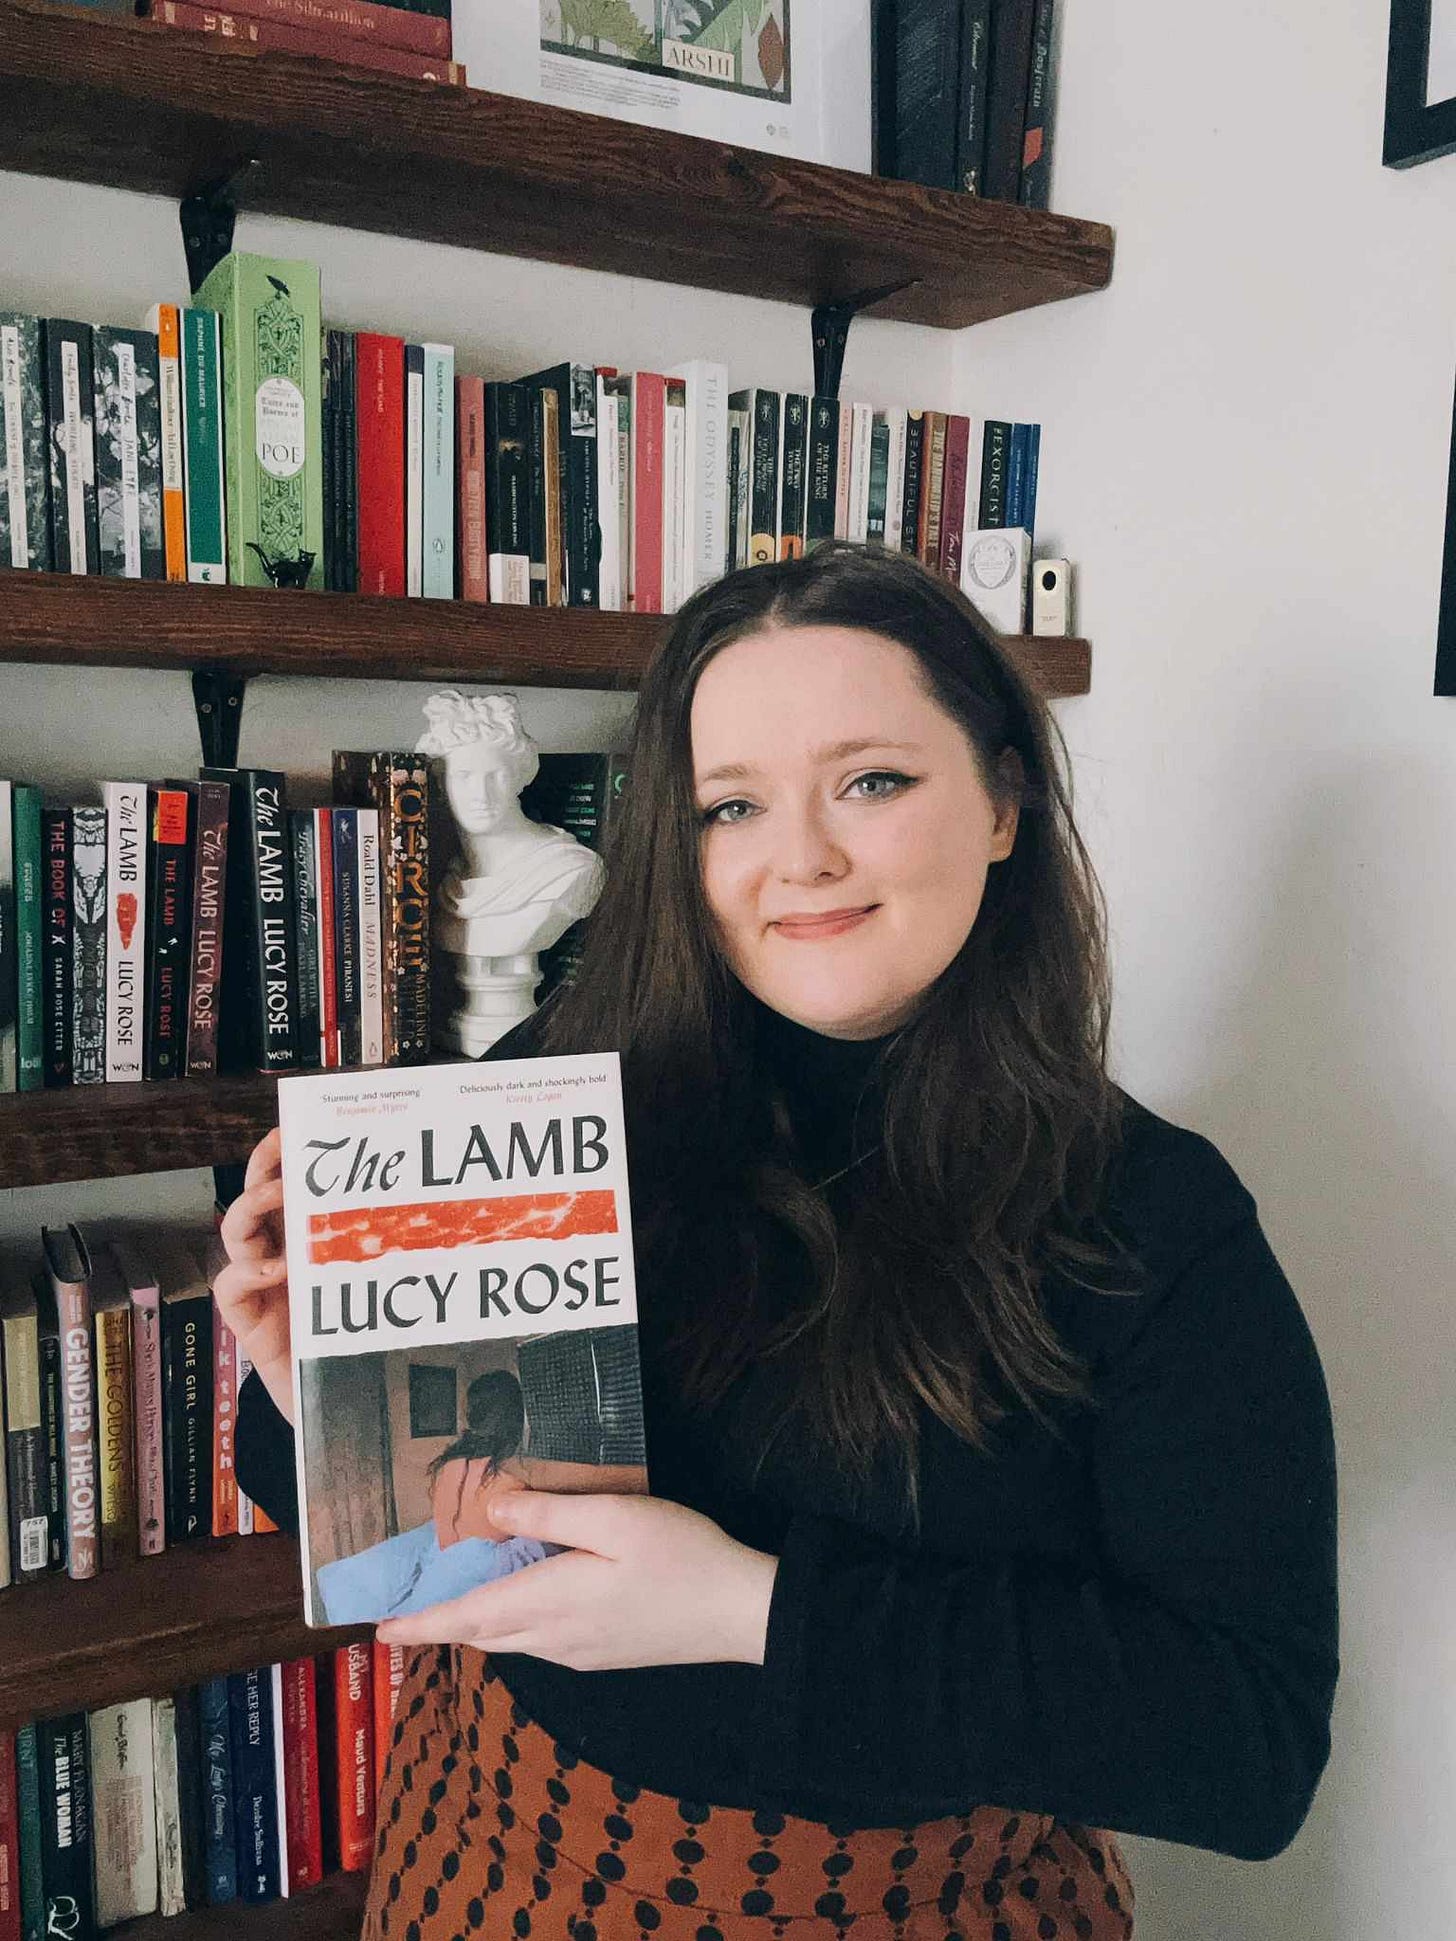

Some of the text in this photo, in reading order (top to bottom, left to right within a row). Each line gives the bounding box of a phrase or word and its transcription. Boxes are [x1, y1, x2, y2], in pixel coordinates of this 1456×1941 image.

[262, 442, 302, 464] POE
[703, 420, 717, 502] ODYSSEY
[814, 476, 822, 500] KING
[821, 464, 829, 500] RETURN
[906, 428, 919, 518] BEAUTIFUL
[927, 430, 944, 548] THE HANDMAID'S TALE
[987, 435, 1003, 525] EXORCIST
[703, 509, 714, 561] HOMER
[118, 795, 138, 1045] The LAMB LUCY ROSE
[254, 787, 289, 1034] The LAMB LUCY ROSE
[293, 832, 315, 935] Tracy Chevalier
[363, 834, 378, 1000] Roald Dahl MADNESS
[393, 788, 431, 966] CIRCE
[51, 821, 66, 1051] THE BOOK OF X SARAH ROSE ETTER
[160, 859, 177, 1037] THE LAMB LUCY ROSE
[194, 829, 221, 1029] The LAMB LUCY ROSE
[341, 872, 353, 1002] SUSANNA CLARKE PIRANESI
[322, 1088, 420, 1104] Stunning and surprising
[459, 1074, 607, 1095] Deliciously dark and shockingly bold
[304, 1115, 609, 1197] The LAMB
[311, 1256, 620, 1336] LUCY ROSE
[105, 1342, 122, 1377] THE
[66, 1328, 95, 1538] GENDER THEORY
[106, 1384, 124, 1472] GOLDENS
[184, 1322, 197, 1504] GONE GIRL GILLIAN FLYNN
[248, 1686, 259, 1710] HER
[348, 1644, 360, 1700] USBAND
[249, 1712, 260, 1745] REPLY
[355, 1729, 367, 1816] Maud Ventura
[54, 1736, 72, 1847] The BLUE WOMAN
[71, 1729, 86, 1843] MARY FLANAGAN
